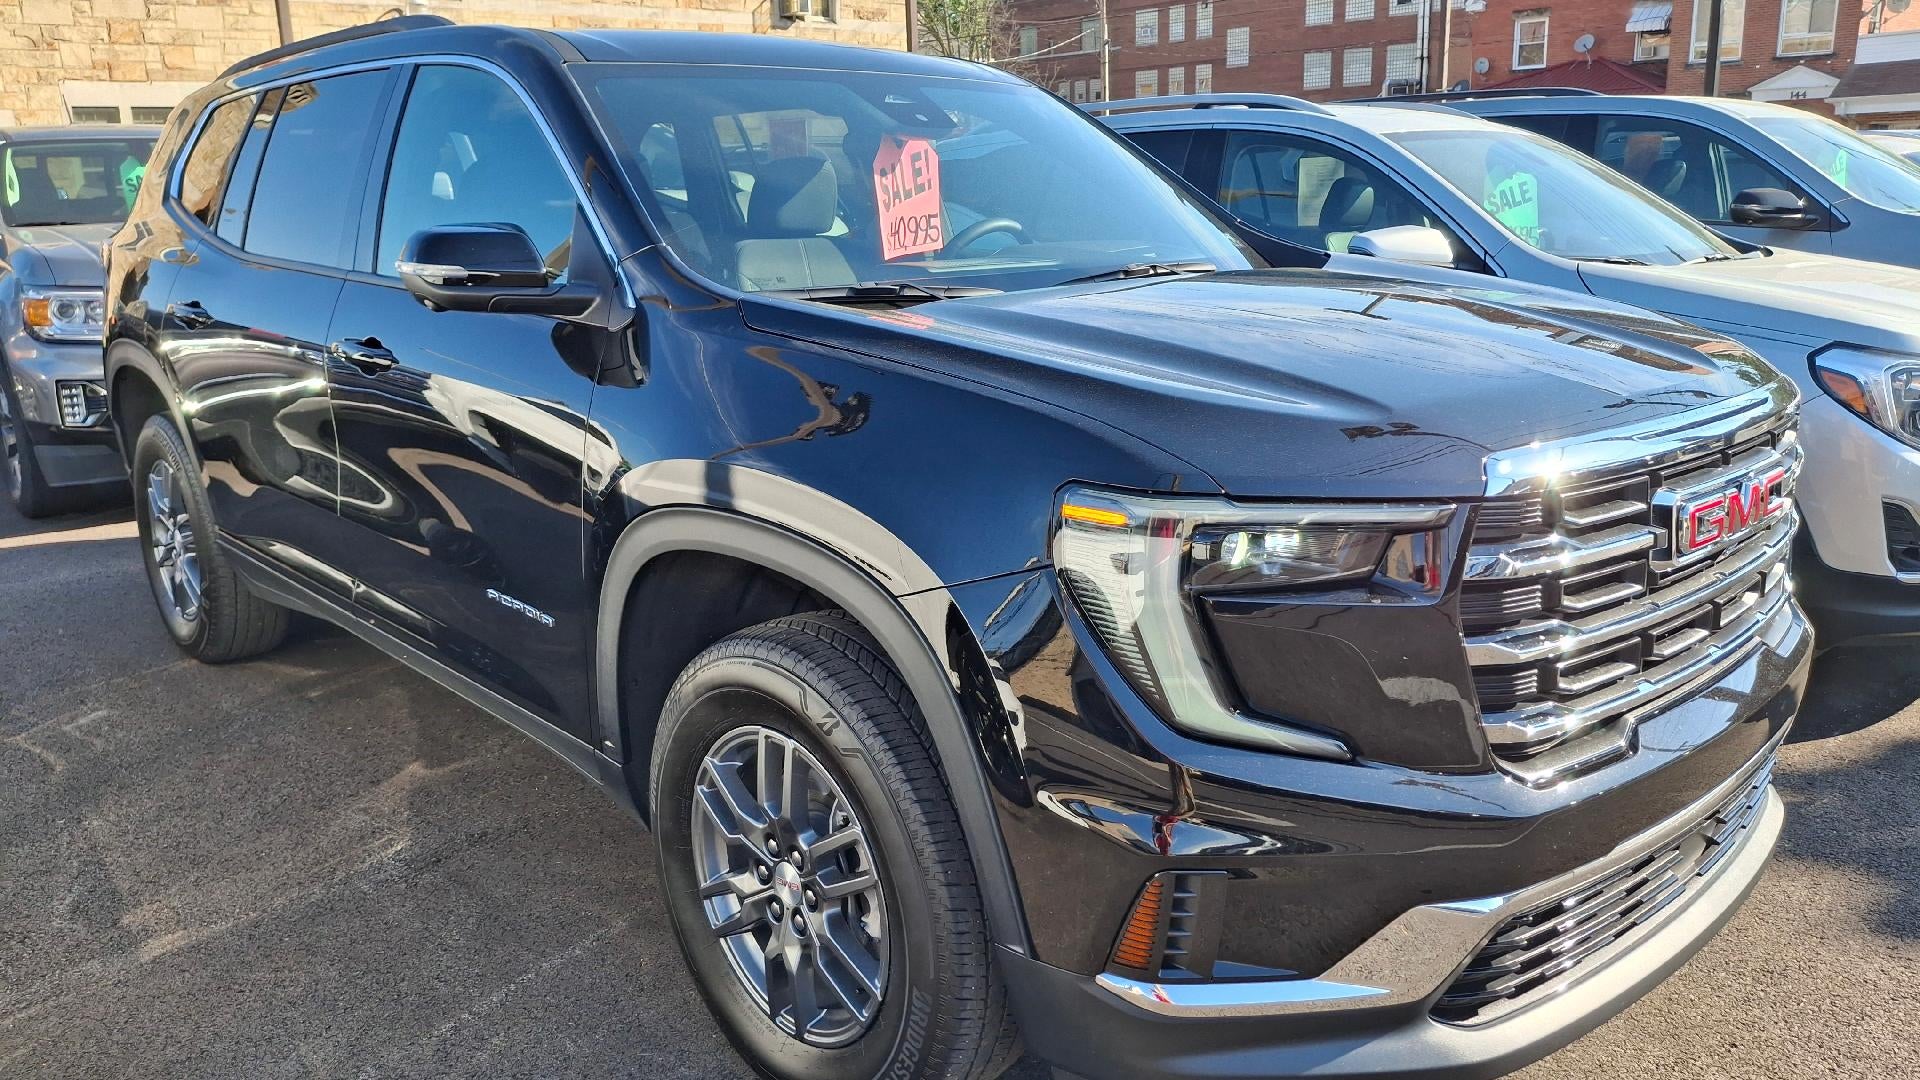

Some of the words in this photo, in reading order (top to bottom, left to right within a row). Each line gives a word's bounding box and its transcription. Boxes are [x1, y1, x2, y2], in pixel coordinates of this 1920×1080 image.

[1790, 90, 1807, 99] 144
[879, 149, 932, 213] SALE!
[1487, 181, 1533, 213] SALE
[1687, 467, 1789, 549] GMC
[486, 588, 555, 628] ACADIA
